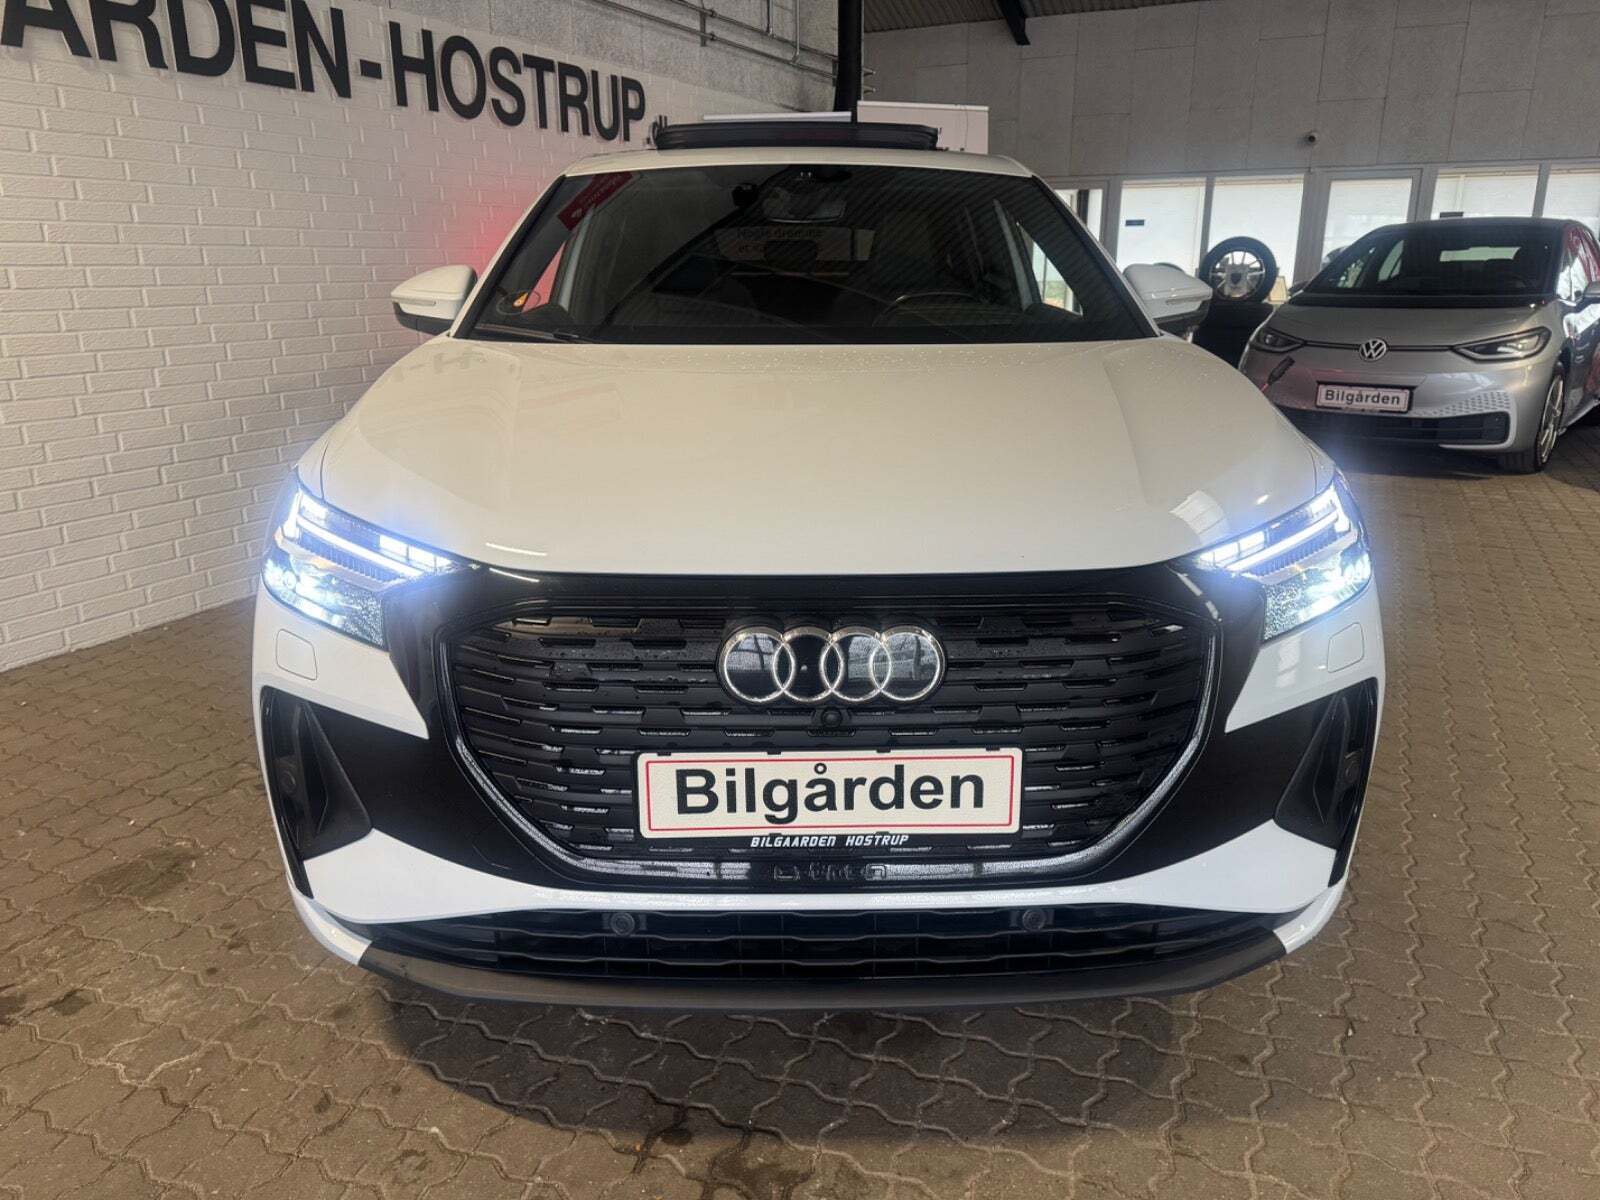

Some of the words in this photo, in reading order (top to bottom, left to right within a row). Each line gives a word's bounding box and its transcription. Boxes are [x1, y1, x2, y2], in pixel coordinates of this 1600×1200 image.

[675, 762, 984, 825] Bilgården
[751, 836, 837, 848] BILGAARDEN
[845, 834, 909, 847] HOSTRUP
